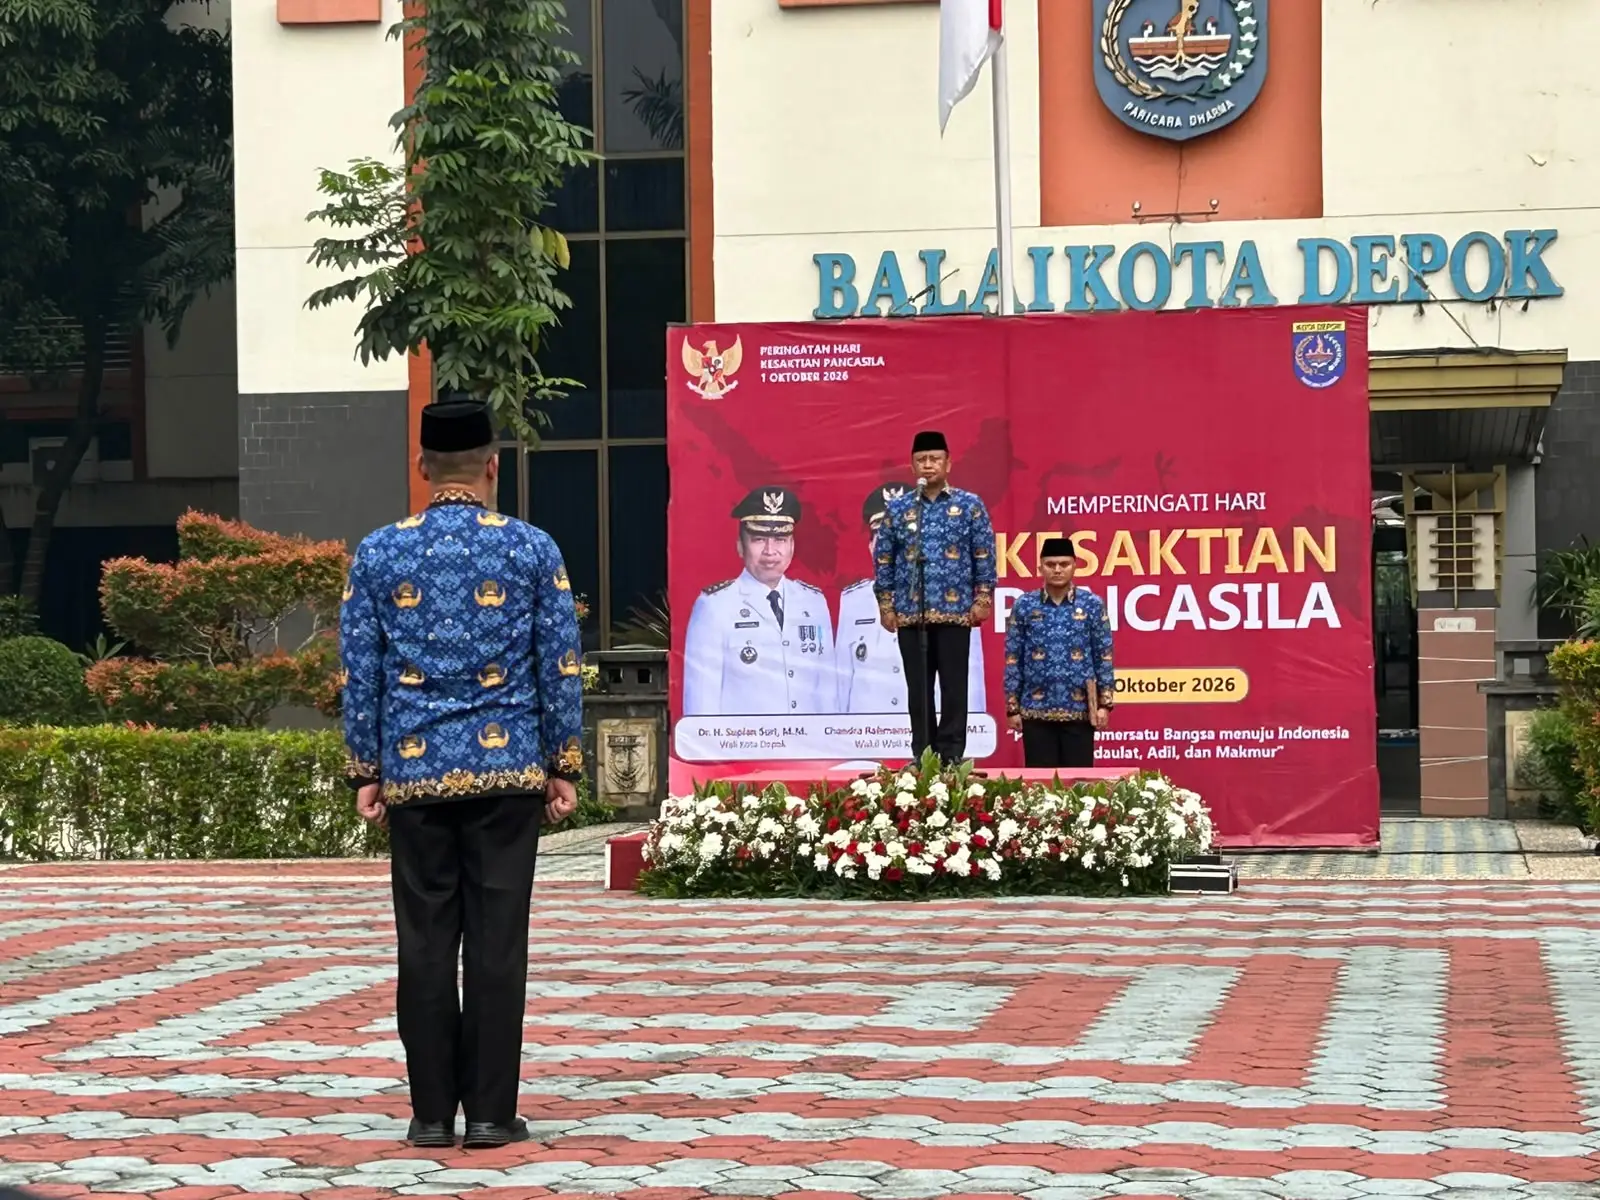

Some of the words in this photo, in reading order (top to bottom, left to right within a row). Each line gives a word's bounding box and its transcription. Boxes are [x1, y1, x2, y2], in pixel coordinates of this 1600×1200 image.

[1123, 101, 1183, 128] PARICARA
[1189, 99, 1236, 127] DHARMA
[1297, 228, 1565, 304] DEPOK
[760, 344, 831, 356] PERINGATAN
[833, 343, 861, 354] HARI
[760, 358, 820, 369] KESAKTIAN
[823, 356, 885, 367] PANCASILA
[760, 373, 766, 382] 1
[769, 372, 820, 382] OKTOBER
[823, 371, 849, 381] 2026
[1047, 493, 1209, 515] MEMPERINGATI
[1215, 492, 1266, 512] HARI
[994, 581, 1342, 634] PCASILA
[1114, 676, 1187, 693] Oktober
[1191, 677, 1236, 692] 2026
[698, 728, 711, 737] Dr.
[713, 728, 723, 737] H.
[865, 725, 912, 737] Rahmansy
[1093, 728, 1159, 741] emersatu
[1163, 727, 1215, 743] Bangsa
[1219, 726, 1274, 743] menuju
[1278, 725, 1350, 740] Indonesia
[1093, 746, 1143, 760] daulat,
[1147, 745, 1180, 760] Adil,
[1184, 745, 1211, 759] dan
